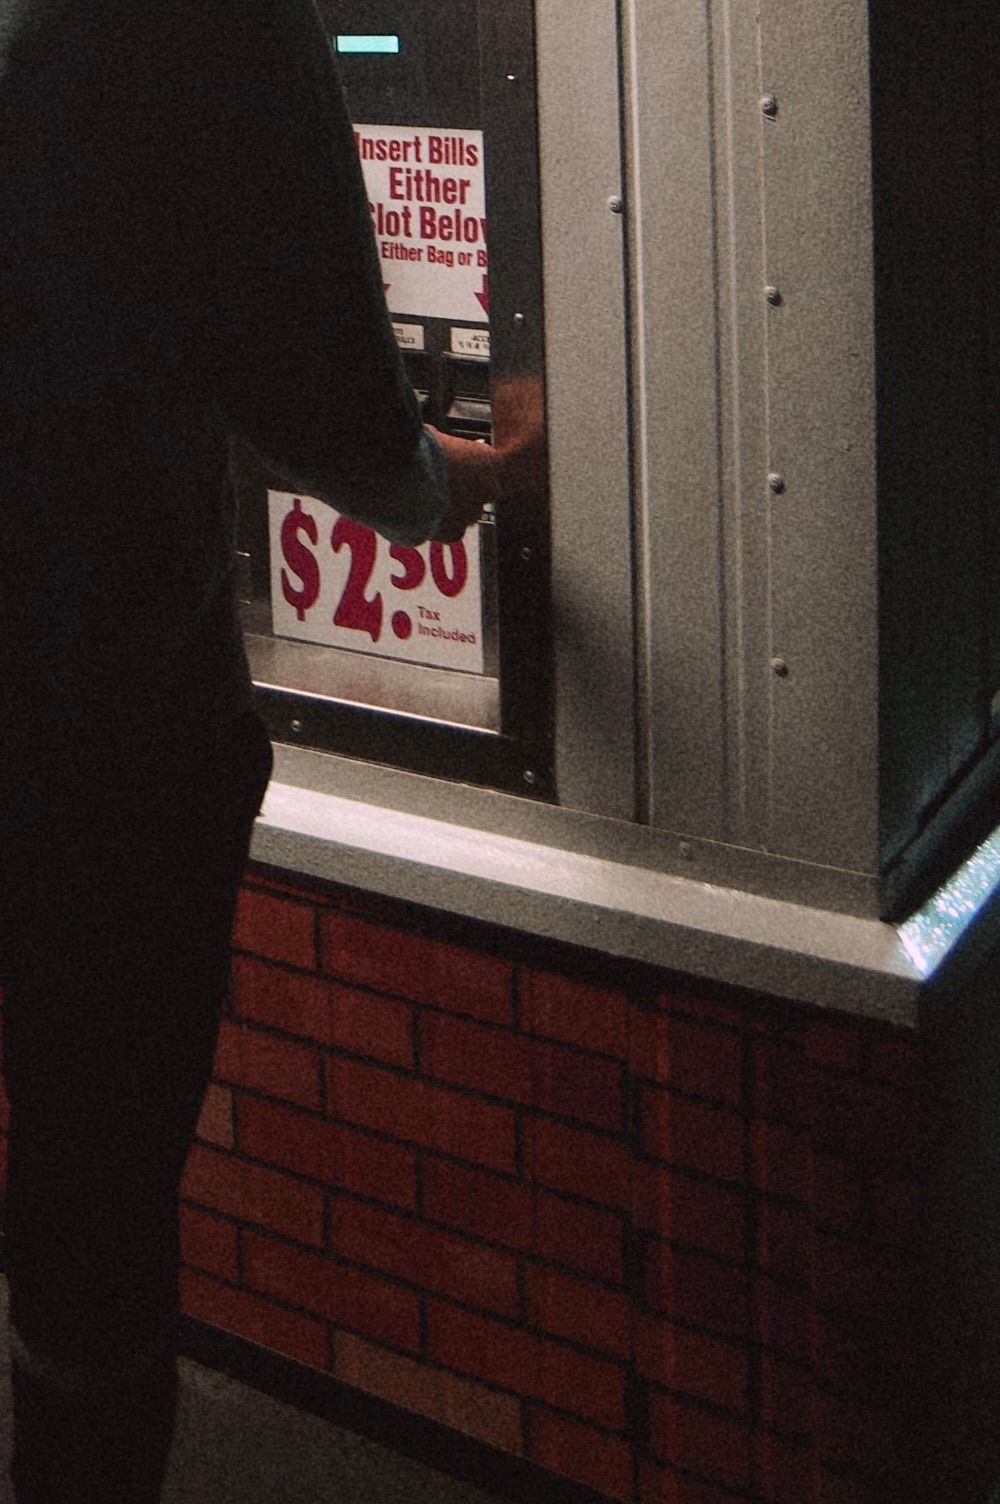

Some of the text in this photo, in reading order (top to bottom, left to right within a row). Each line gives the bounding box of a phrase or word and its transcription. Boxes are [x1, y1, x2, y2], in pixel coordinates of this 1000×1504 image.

[428, 135, 478, 167] Bills
[389, 167, 471, 205] Either
[381, 241, 423, 262] Either
[427, 245, 454, 267] Bag
[458, 252, 473, 266] or
[417, 605, 441, 622] Tax
[418, 623, 476, 644] Included
